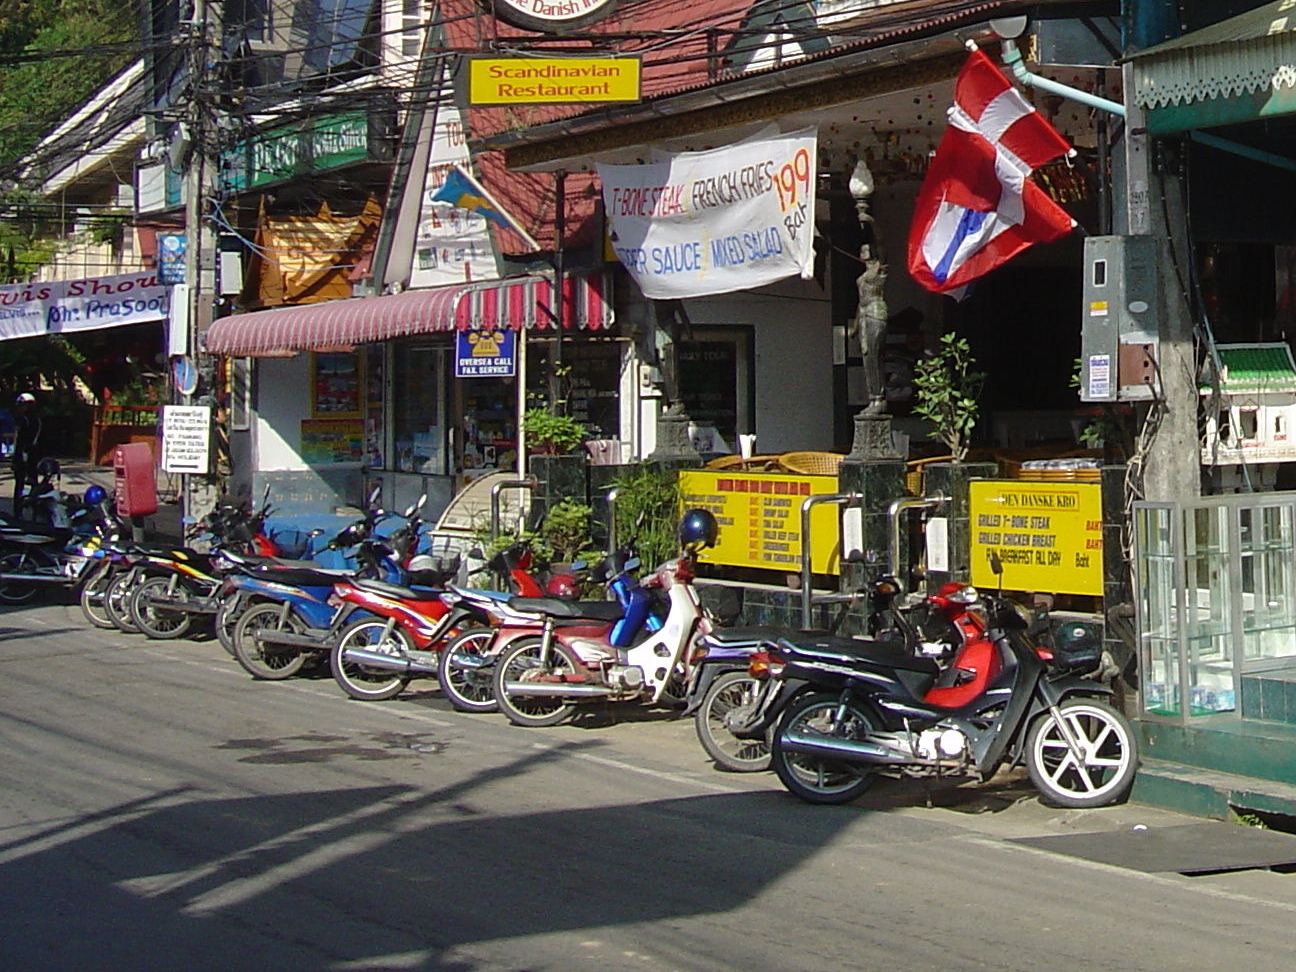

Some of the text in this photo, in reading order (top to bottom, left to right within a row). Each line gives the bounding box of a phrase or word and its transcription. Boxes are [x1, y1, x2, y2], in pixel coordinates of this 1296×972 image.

[489, 65, 620, 78] Scandinavian
[497, 82, 610, 97] Restaurant
[613, 147, 811, 216] T-BONE STEAK FRENCH FRIES 199
[652, 242, 701, 274] SAUCE
[710, 236, 745, 267] MIXED
[743, 227, 782, 261] SALAD
[460, 358, 492, 366] OVERSEA
[479, 366, 508, 374] SERVICE
[1021, 494, 1055, 507] DANSKE
[1057, 494, 1076, 508] KRO
[978, 514, 1001, 527] GRILLED
[1002, 515, 1029, 528] T-BONE
[1030, 516, 1051, 529] STEAK
[978, 532, 1001, 545] GRILLED
[1003, 533, 1030, 546] CHICKEN
[1031, 534, 1056, 547] BREAST
[1036, 550, 1046, 565] ALL
[1048, 551, 1061, 566] DAY
